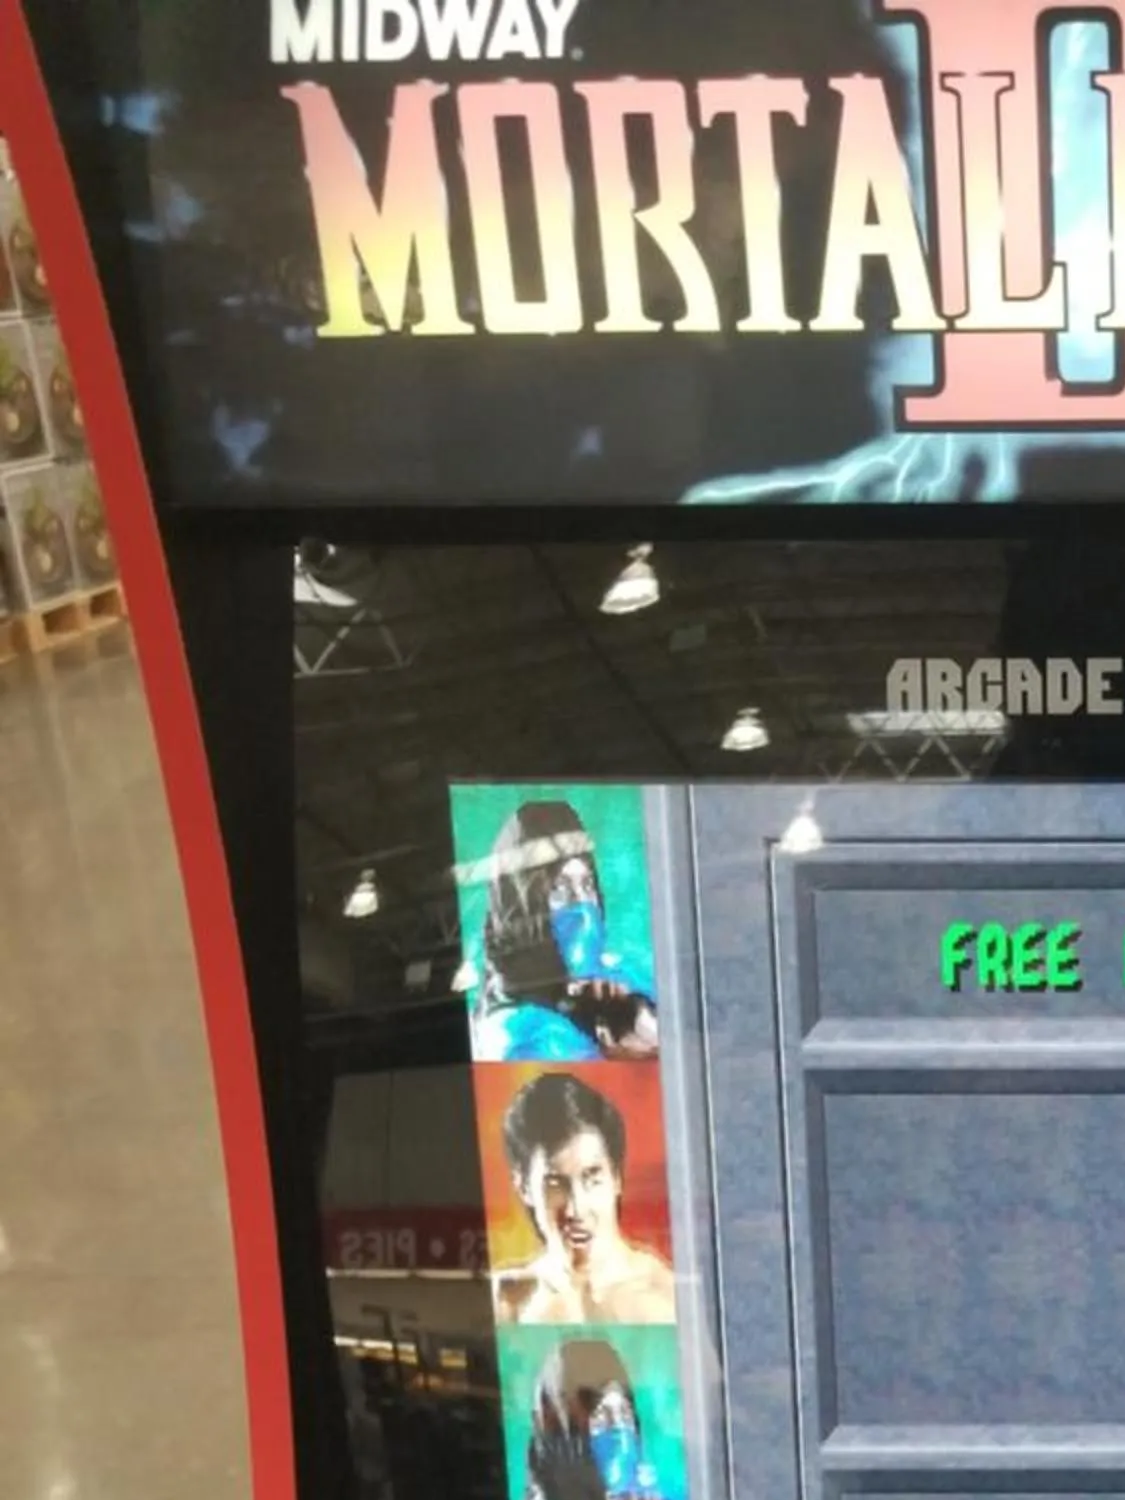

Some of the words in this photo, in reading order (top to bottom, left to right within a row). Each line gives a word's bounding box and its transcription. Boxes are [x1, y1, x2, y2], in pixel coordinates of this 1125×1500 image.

[271, 0, 580, 63] MIDWAY
[279, 74, 1067, 339] MORTAL
[940, 920, 1082, 992] FREE
